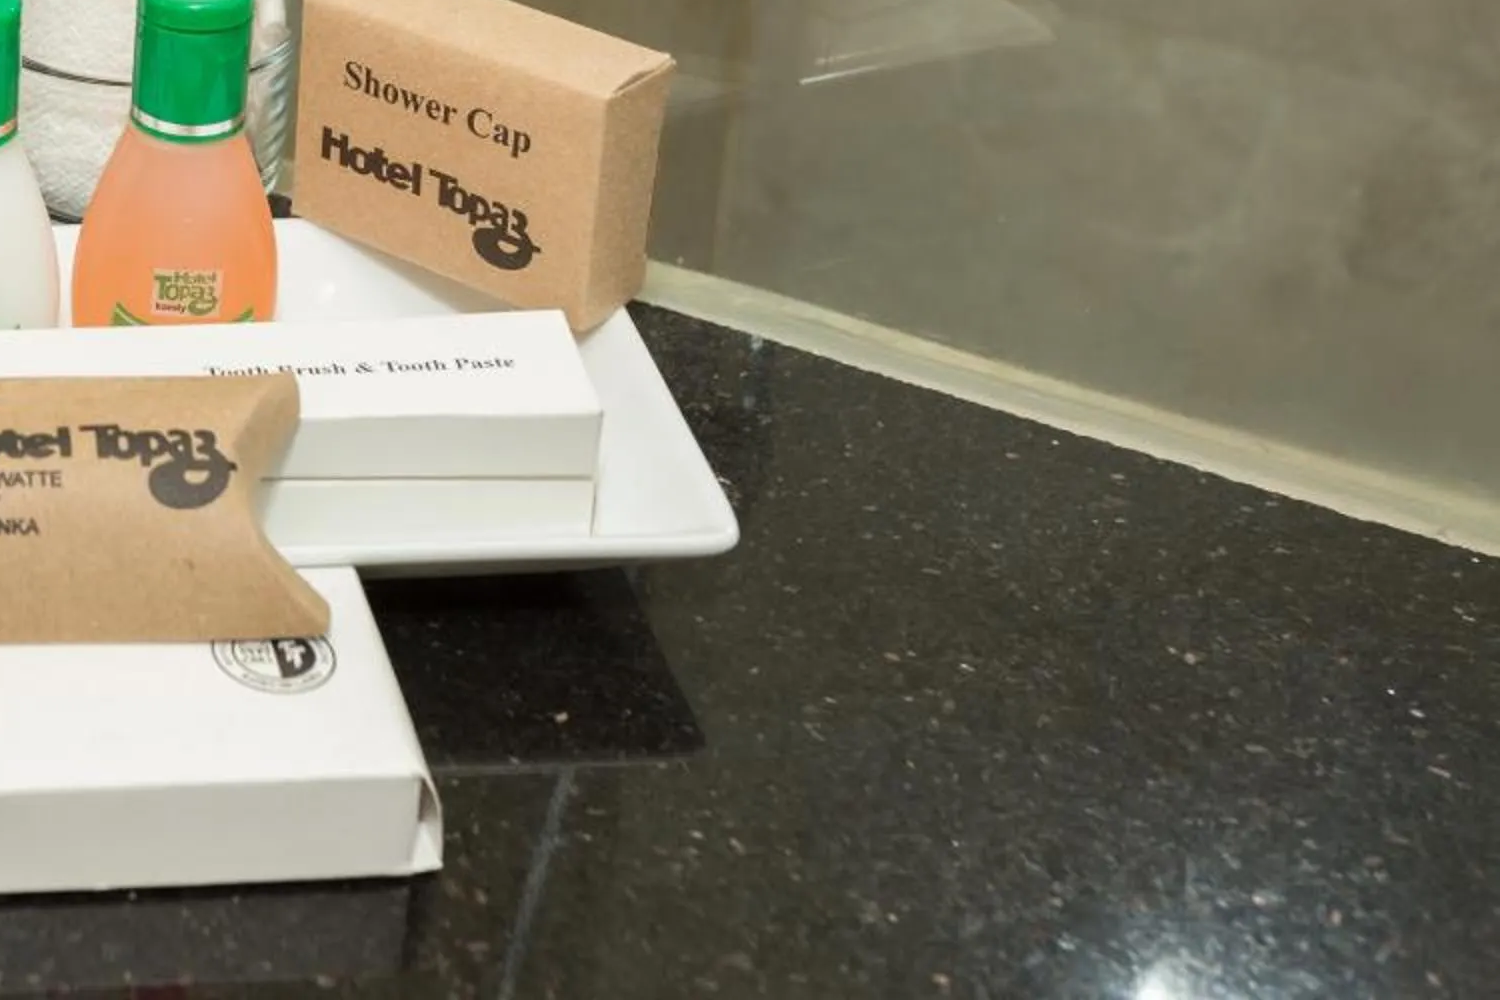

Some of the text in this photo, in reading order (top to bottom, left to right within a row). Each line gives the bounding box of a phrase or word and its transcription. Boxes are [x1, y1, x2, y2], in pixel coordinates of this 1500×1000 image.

[343, 60, 532, 159] Shower Cap
[321, 126, 542, 271] Hotel Topaz
[154, 275, 218, 316] Topaz
[174, 271, 217, 284] Hotel
[355, 360, 375, 374] &
[380, 359, 448, 374] Tooth
[453, 357, 515, 371] Paste
[78, 424, 238, 510] Topaz
